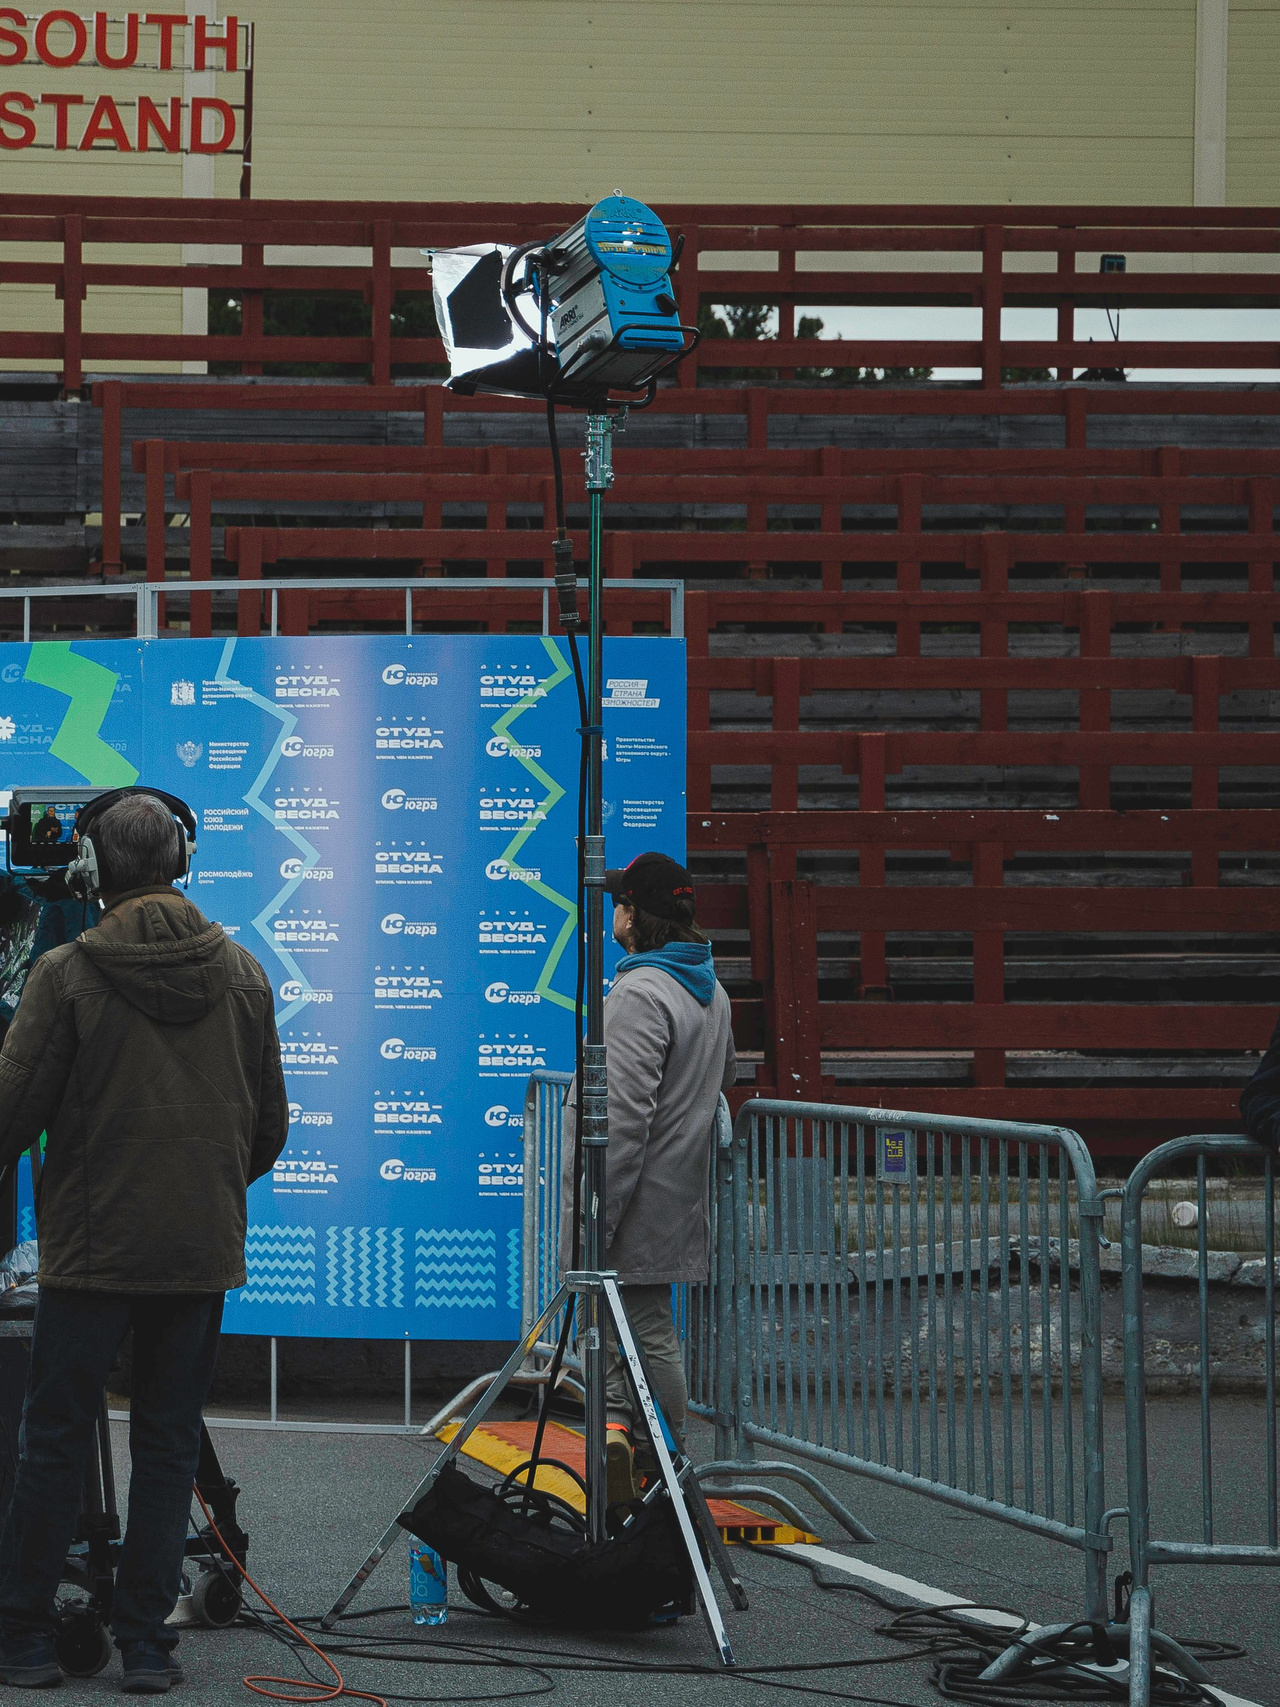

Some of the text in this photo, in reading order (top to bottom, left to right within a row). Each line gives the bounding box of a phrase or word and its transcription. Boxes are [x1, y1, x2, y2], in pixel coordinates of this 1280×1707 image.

[276, 676, 340, 685] СТУД-
[480, 676, 547, 685] СТУД-
[276, 688, 340, 697] ВЕСНА
[480, 687, 547, 697] ВЕСНА
[602, 698, 656, 706] ОЗМОЖНОСТЕЙ
[376, 727, 443, 736] СТУД-
[376, 739, 443, 748] ВЕСНА
[275, 798, 340, 807] СТУД-
[480, 798, 547, 808] СТУД-
[275, 810, 340, 819] ВЕСНА
[480, 810, 547, 820] ВЕСНА
[375, 852, 443, 861] СТУД-
[375, 864, 443, 873] ВЕСНА
[274, 920, 339, 929] СТУД-
[479, 922, 546, 930] СТУД-
[274, 932, 339, 941] ВЕСНА
[479, 933, 546, 942] ВЕСНА
[374, 977, 442, 986] СТУД-
[374, 988, 442, 998] ВЕСНА
[478, 1045, 546, 1054] СТУД-
[478, 1056, 546, 1066] ВЕСНА
[374, 1102, 442, 1110] СТУД-
[374, 1113, 442, 1122] ВЕСНА
[273, 1160, 338, 1170] СТУД-
[273, 1172, 338, 1182] ВЕСНА
